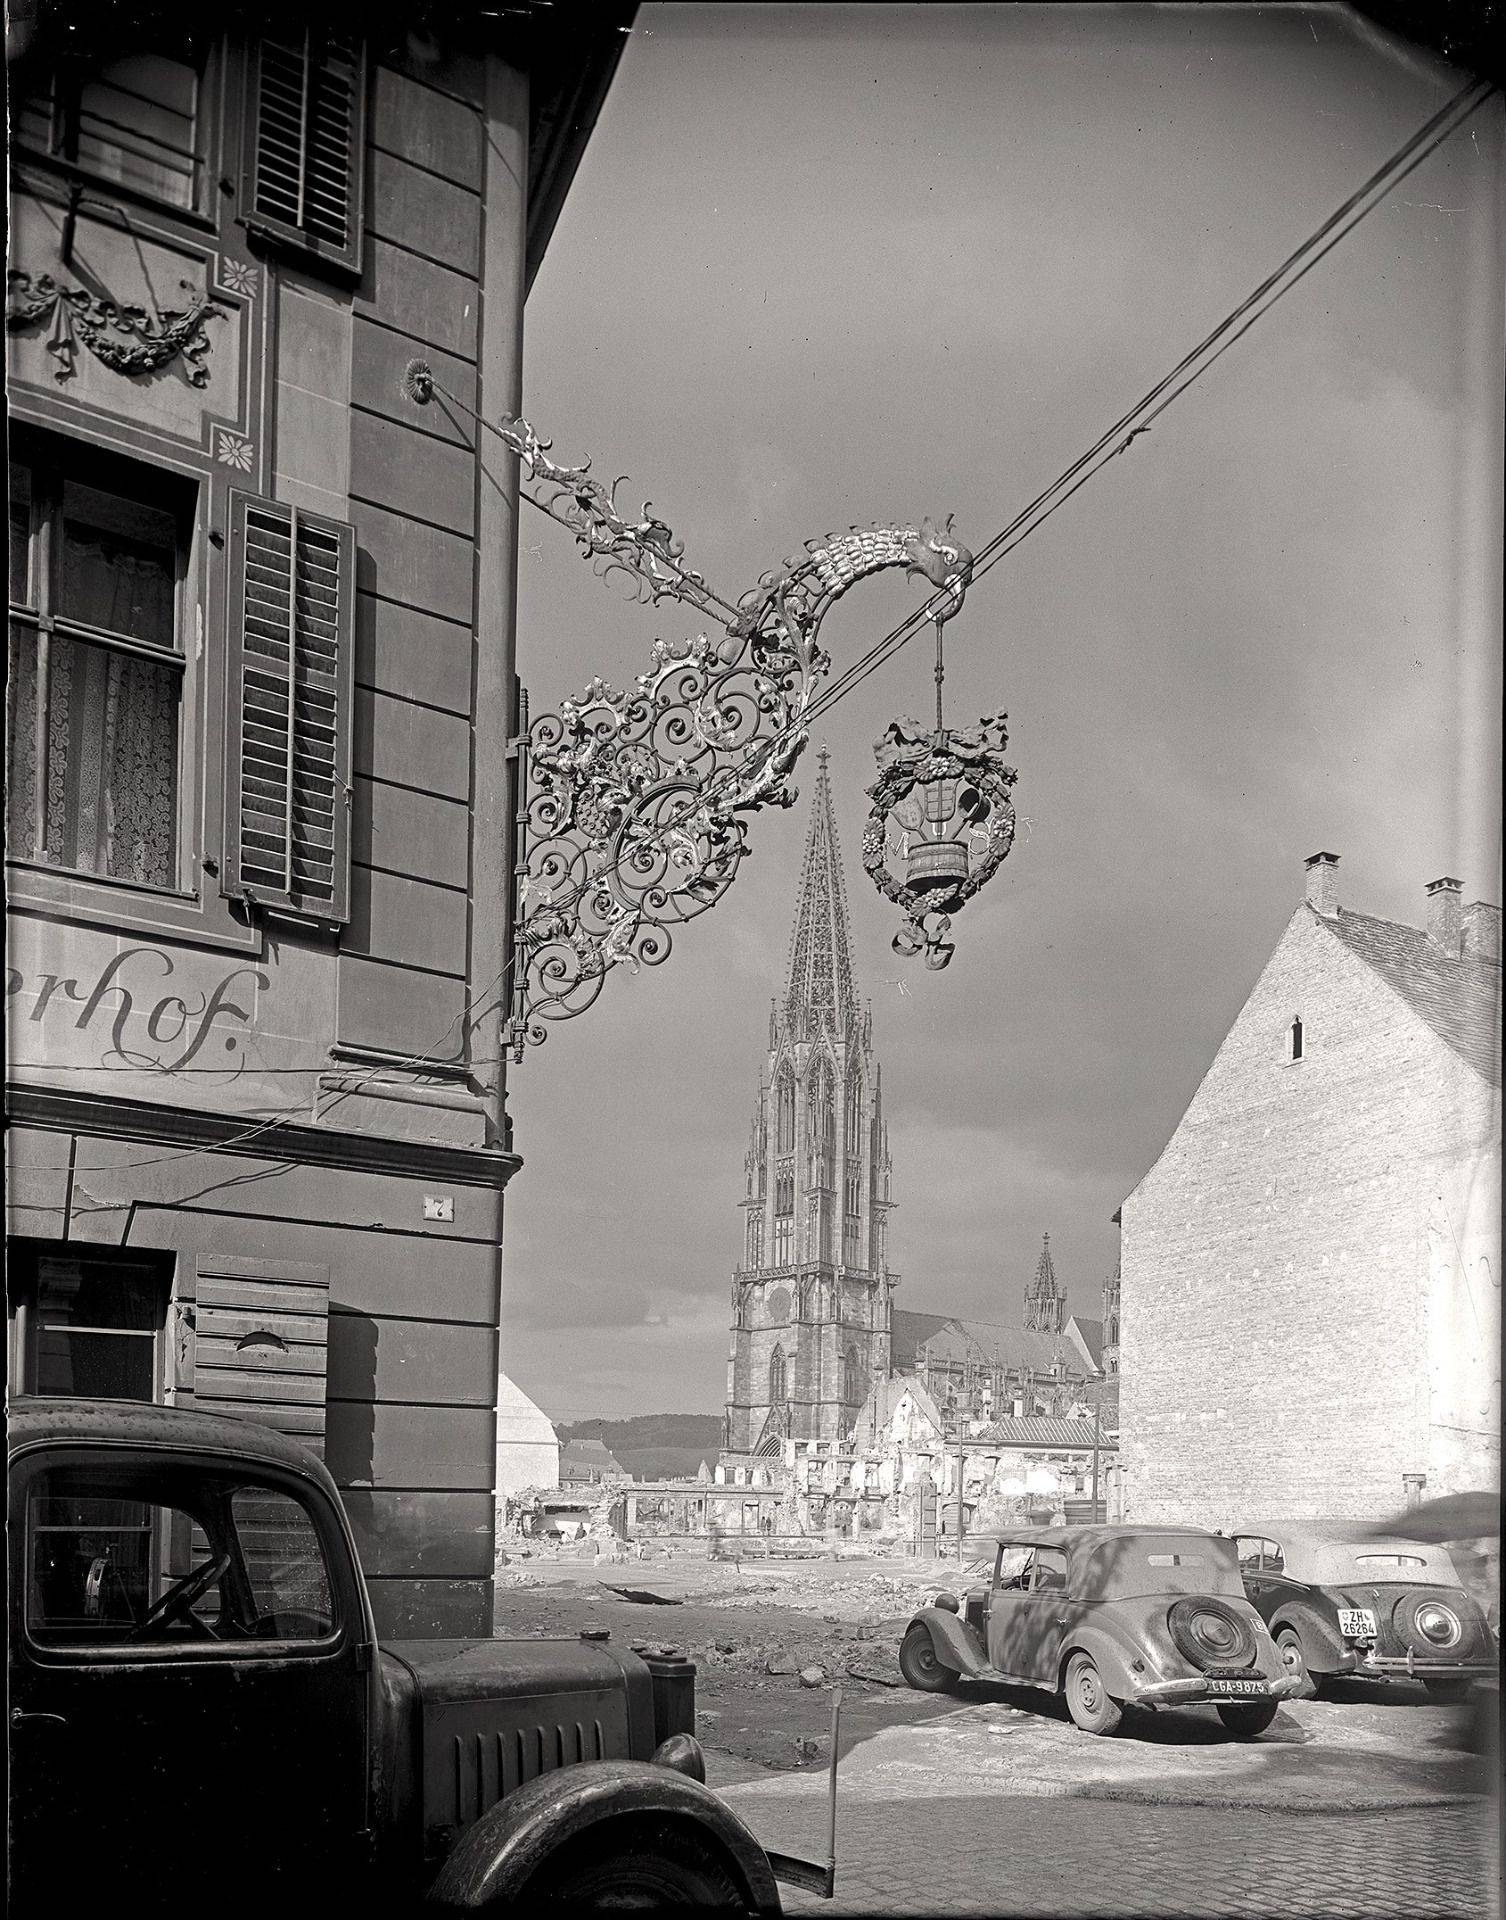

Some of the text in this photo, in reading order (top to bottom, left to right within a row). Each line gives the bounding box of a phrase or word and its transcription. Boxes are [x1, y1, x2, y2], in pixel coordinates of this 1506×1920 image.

[434, 1199, 444, 1217] 7
[1350, 1611, 1364, 1622] ZH
[1344, 1623, 1375, 1634] 26264
